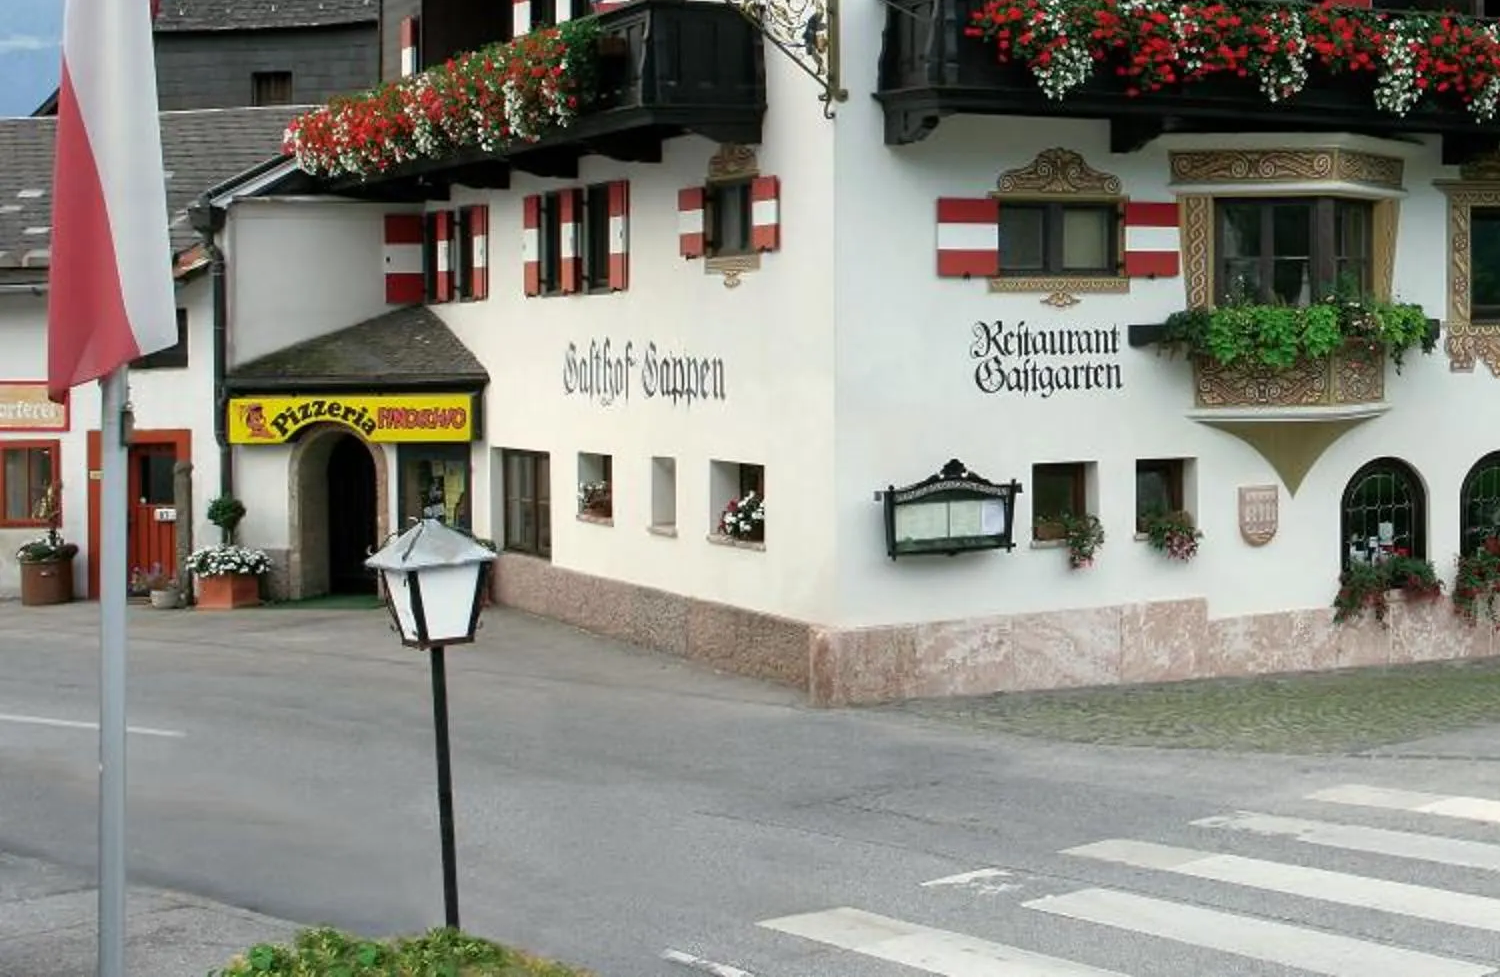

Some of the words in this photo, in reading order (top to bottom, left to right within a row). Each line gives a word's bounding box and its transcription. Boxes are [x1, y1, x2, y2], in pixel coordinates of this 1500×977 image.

[970, 320, 1120, 359] Restaurant
[974, 355, 1123, 398] Gastgarten
[271, 399, 376, 436] Pizzeria
